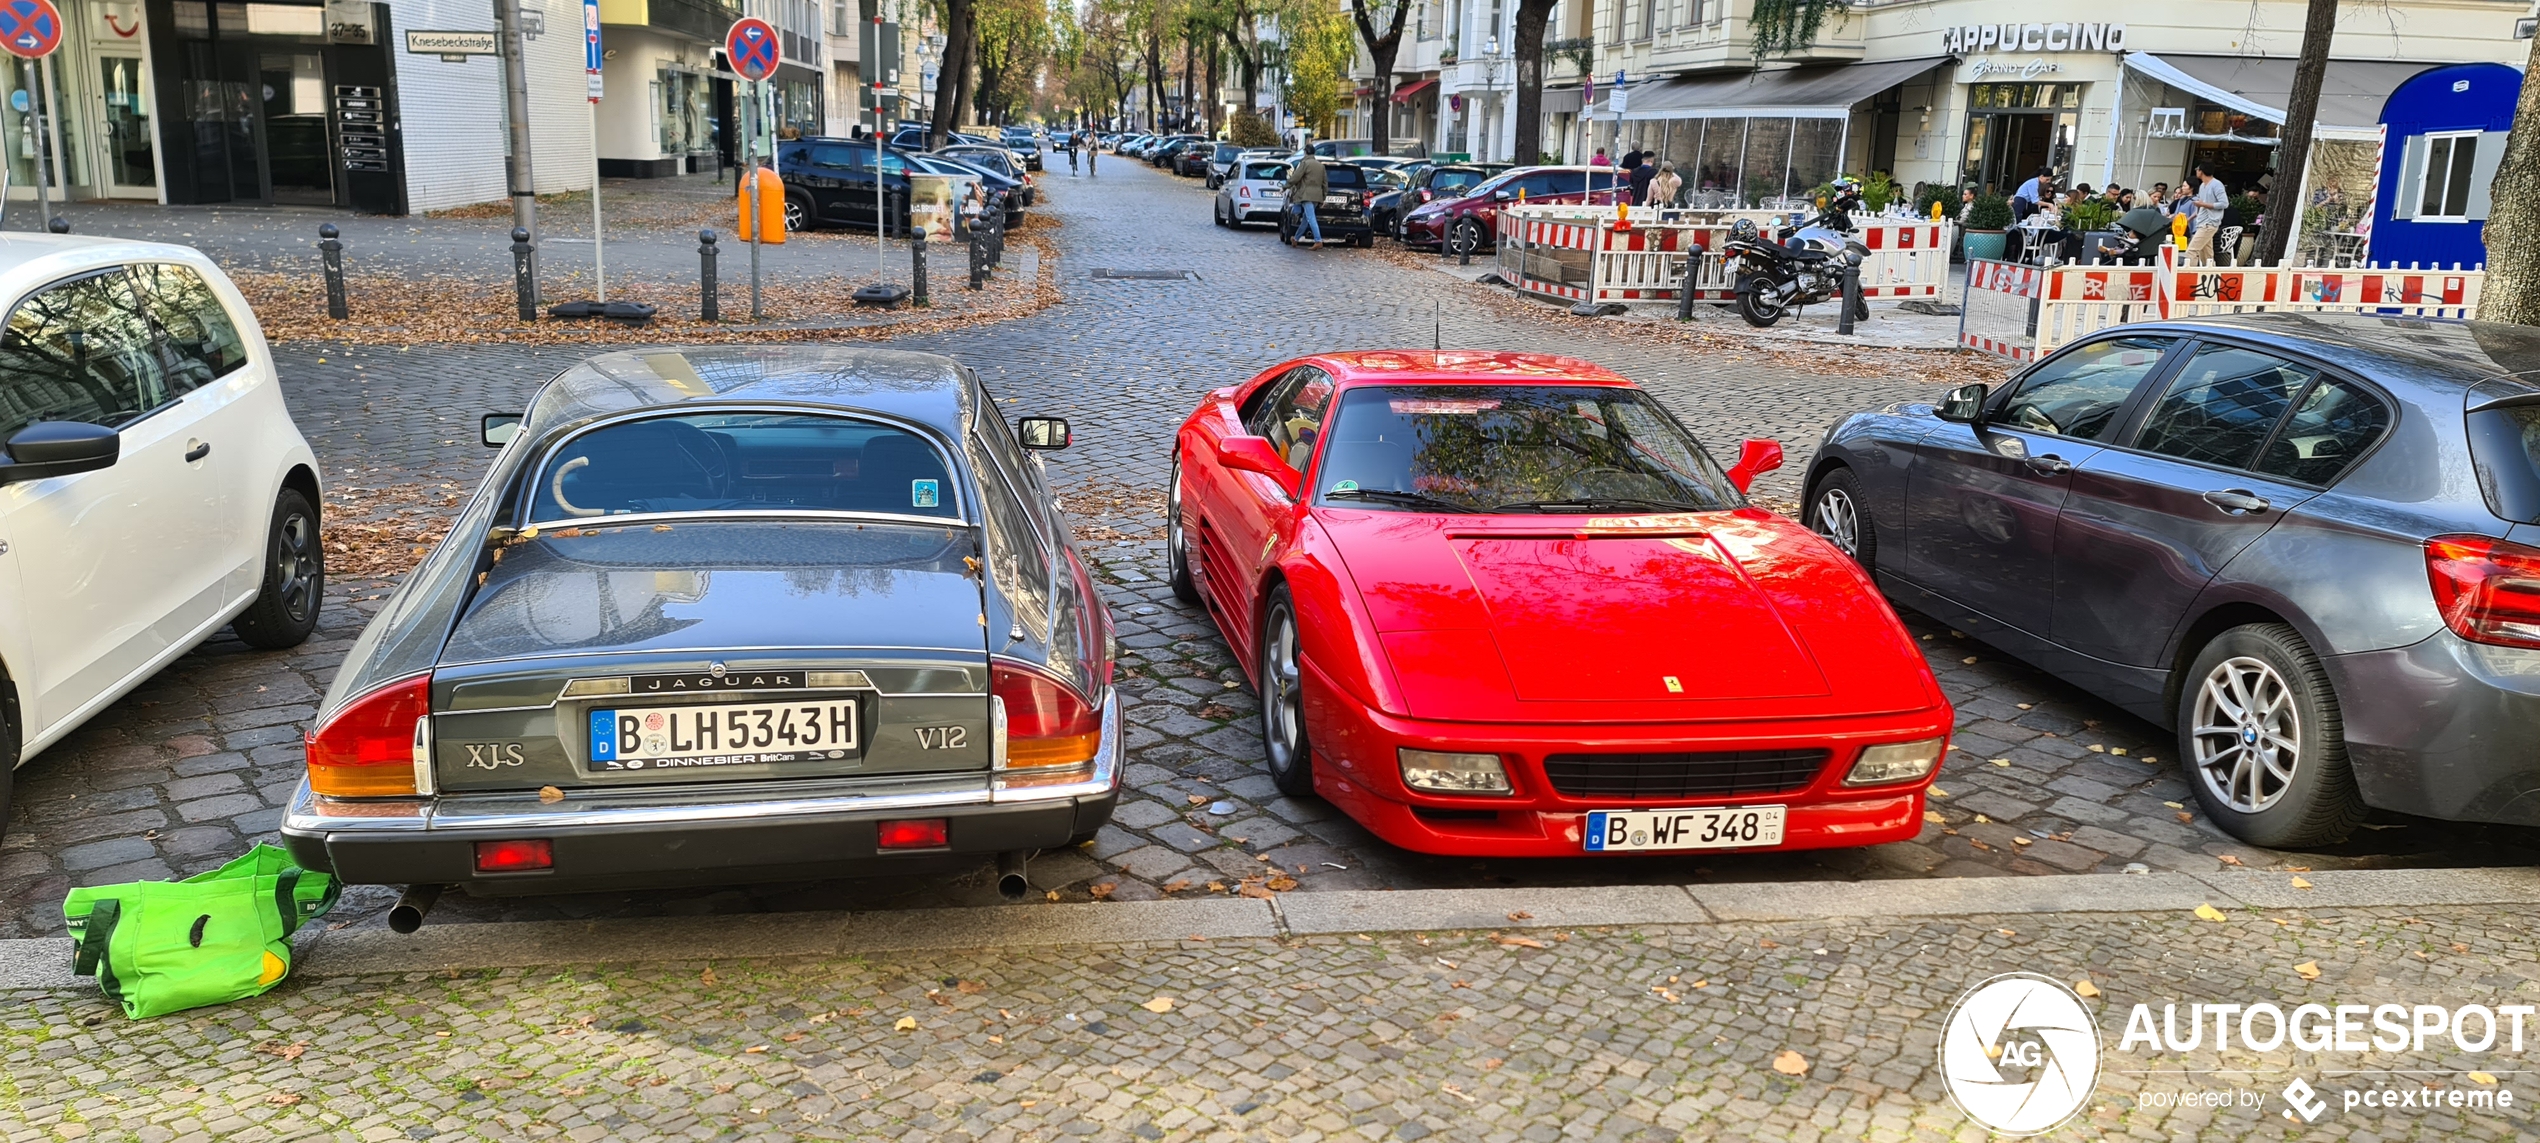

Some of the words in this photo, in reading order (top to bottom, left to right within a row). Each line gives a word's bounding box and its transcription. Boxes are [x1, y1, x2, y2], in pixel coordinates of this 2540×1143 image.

[411, 35, 493, 50] Knesebeckstraße
[1942, 23, 2126, 52] CAPPUCCINO
[1971, 58, 2018, 83] GRAND
[649, 676, 791, 689] JAGUAR
[619, 715, 641, 754] B
[915, 727, 968, 750] V12
[599, 742, 609, 753] D
[466, 743, 524, 768] XJS
[656, 756, 756, 767] DINNEBIER
[760, 753, 796, 763] BritCars
[1765, 811, 1778, 820] 04
[1608, 817, 1628, 846] B
[1652, 815, 1694, 845] WF
[1701, 812, 1759, 843] 348
[1764, 831, 1776, 840] 10
[1591, 835, 1600, 844] D
